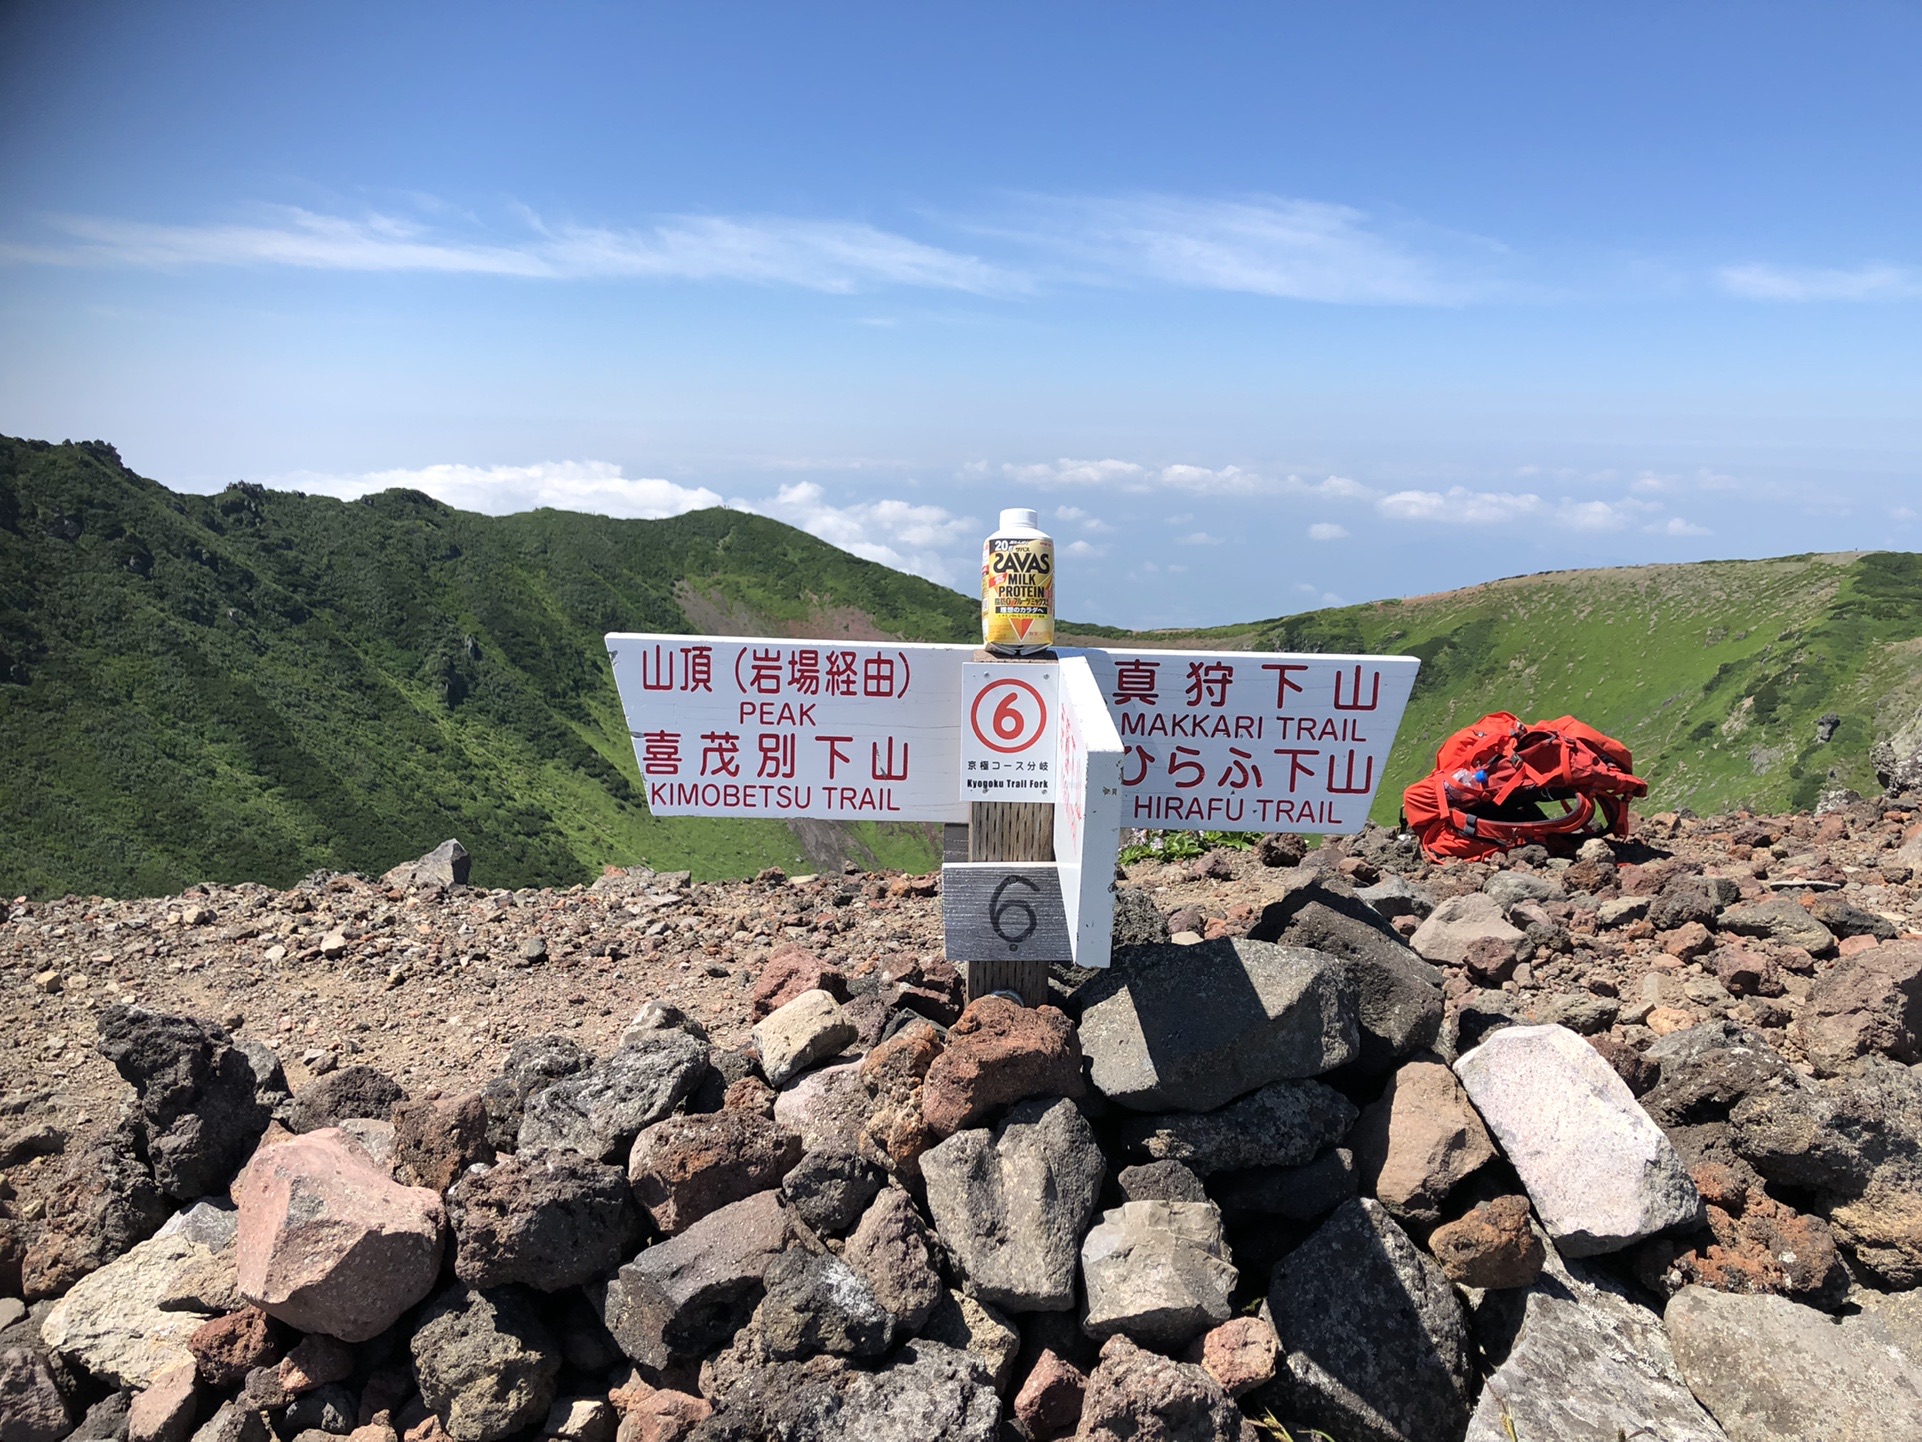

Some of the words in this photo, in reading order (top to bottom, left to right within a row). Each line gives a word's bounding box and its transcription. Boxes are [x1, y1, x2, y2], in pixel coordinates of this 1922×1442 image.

[993, 553, 1050, 574] SAVAS
[999, 586, 1045, 598] PROTEIN
[1008, 574, 1036, 585] MILK
[1112, 659, 1380, 711] 真狩下山
[740, 702, 816, 726] PEAK
[993, 692, 1025, 740] 6
[1121, 712, 1263, 740] MAKKARI
[1276, 716, 1367, 742] TRAIL
[643, 730, 908, 780] 喜茂別下山
[967, 760, 1049, 772] 京極コース分岐
[1121, 745, 1373, 794] ひらふ下山
[651, 782, 811, 809] KIMOBETSU
[822, 787, 900, 811] TRAIL
[967, 779, 1004, 789] Kyogoku
[1006, 779, 1027, 788] Trail
[1029, 780, 1048, 788] Fork
[1134, 795, 1244, 822] HIRAFU
[1257, 800, 1343, 824] TRAIL
[989, 875, 1040, 943] 6
